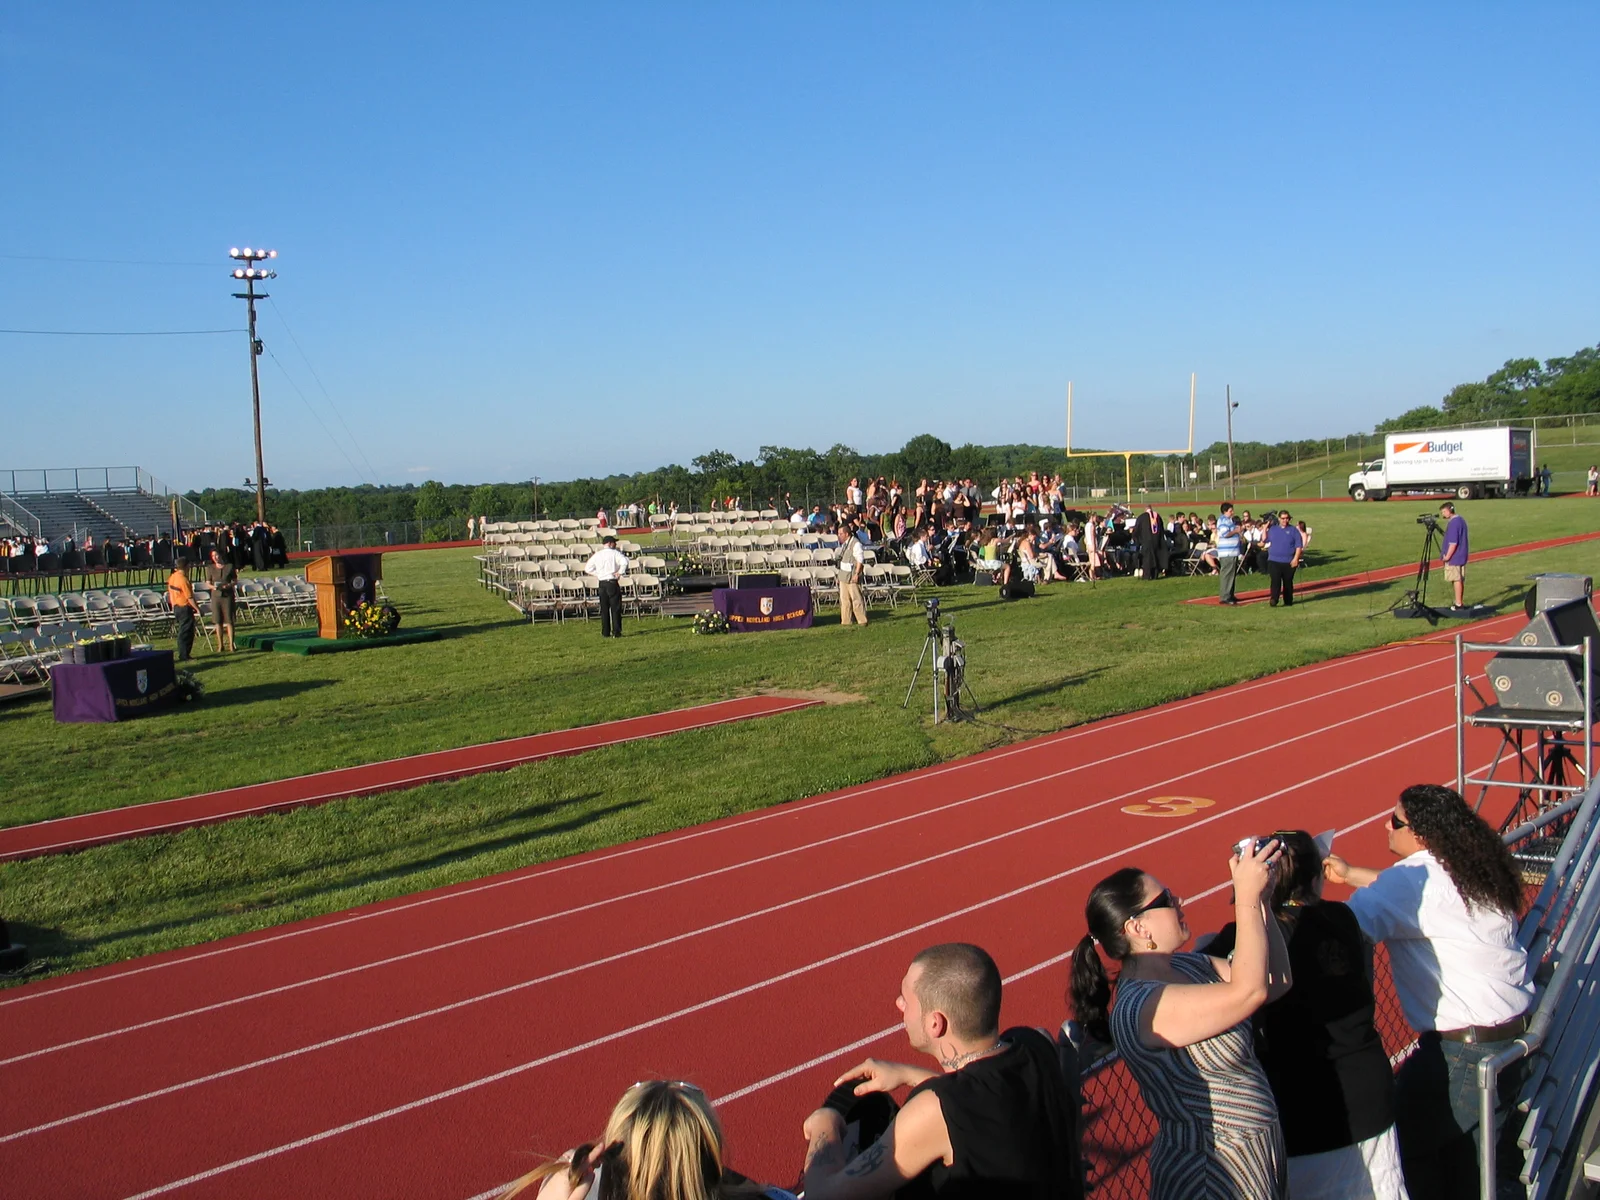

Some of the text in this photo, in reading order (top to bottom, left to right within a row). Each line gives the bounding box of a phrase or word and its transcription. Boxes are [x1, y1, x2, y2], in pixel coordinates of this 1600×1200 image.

[1427, 440, 1463, 454] Budget
[773, 614, 785, 622] HIGH
[786, 609, 806, 620] SCHOOL
[1120, 795, 1217, 818] 3
